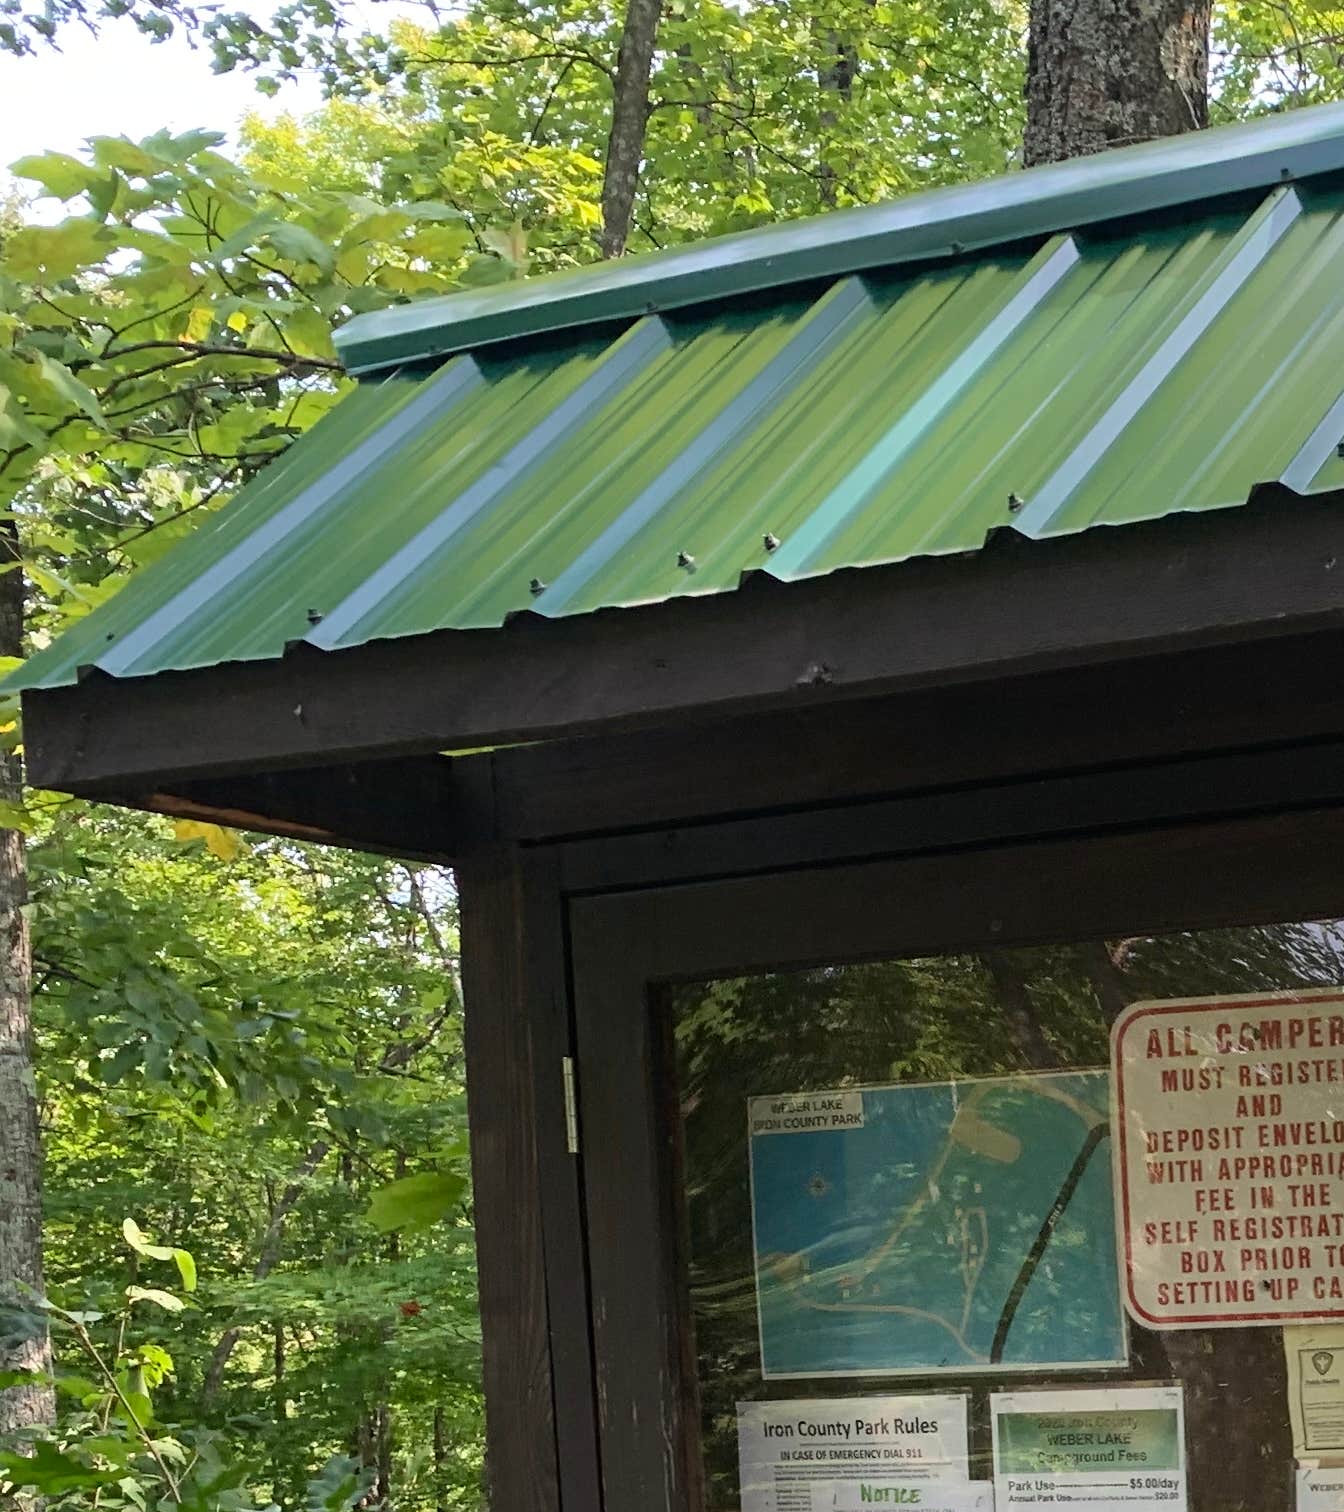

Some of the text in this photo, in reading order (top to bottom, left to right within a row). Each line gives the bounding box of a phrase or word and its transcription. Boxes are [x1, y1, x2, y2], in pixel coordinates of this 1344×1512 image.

[1146, 1027, 1198, 1059] ALL
[1162, 1066, 1225, 1092] MUST
[813, 1099, 843, 1111] LAKE
[1236, 1094, 1282, 1118] AND
[753, 1113, 863, 1130] IRON COUNTY PARK
[1147, 1126, 1244, 1153] DEPOSIT
[1147, 1160, 1203, 1184] WITH
[1195, 1183, 1331, 1212] FEE IN THE
[1145, 1220, 1199, 1245] SELF
[1181, 1250, 1225, 1273] BOX
[1240, 1245, 1311, 1270] PRIOR
[1158, 1280, 1255, 1306] SETTING
[1270, 1278, 1299, 1300] UP
[764, 1417, 938, 1440] Iron County Park Rules
[1048, 1432, 1132, 1446] WEBER LAKE
[780, 1448, 922, 1461] IN CASE OF EMERGENCY DIAL 911
[1118, 1450, 1148, 1462] Fees
[860, 1484, 922, 1504] NOTICE
[1008, 1478, 1180, 1491] Park Use $5.00/day
[1038, 1494, 1054, 1502] Park
[1056, 1494, 1072, 1502] Use
